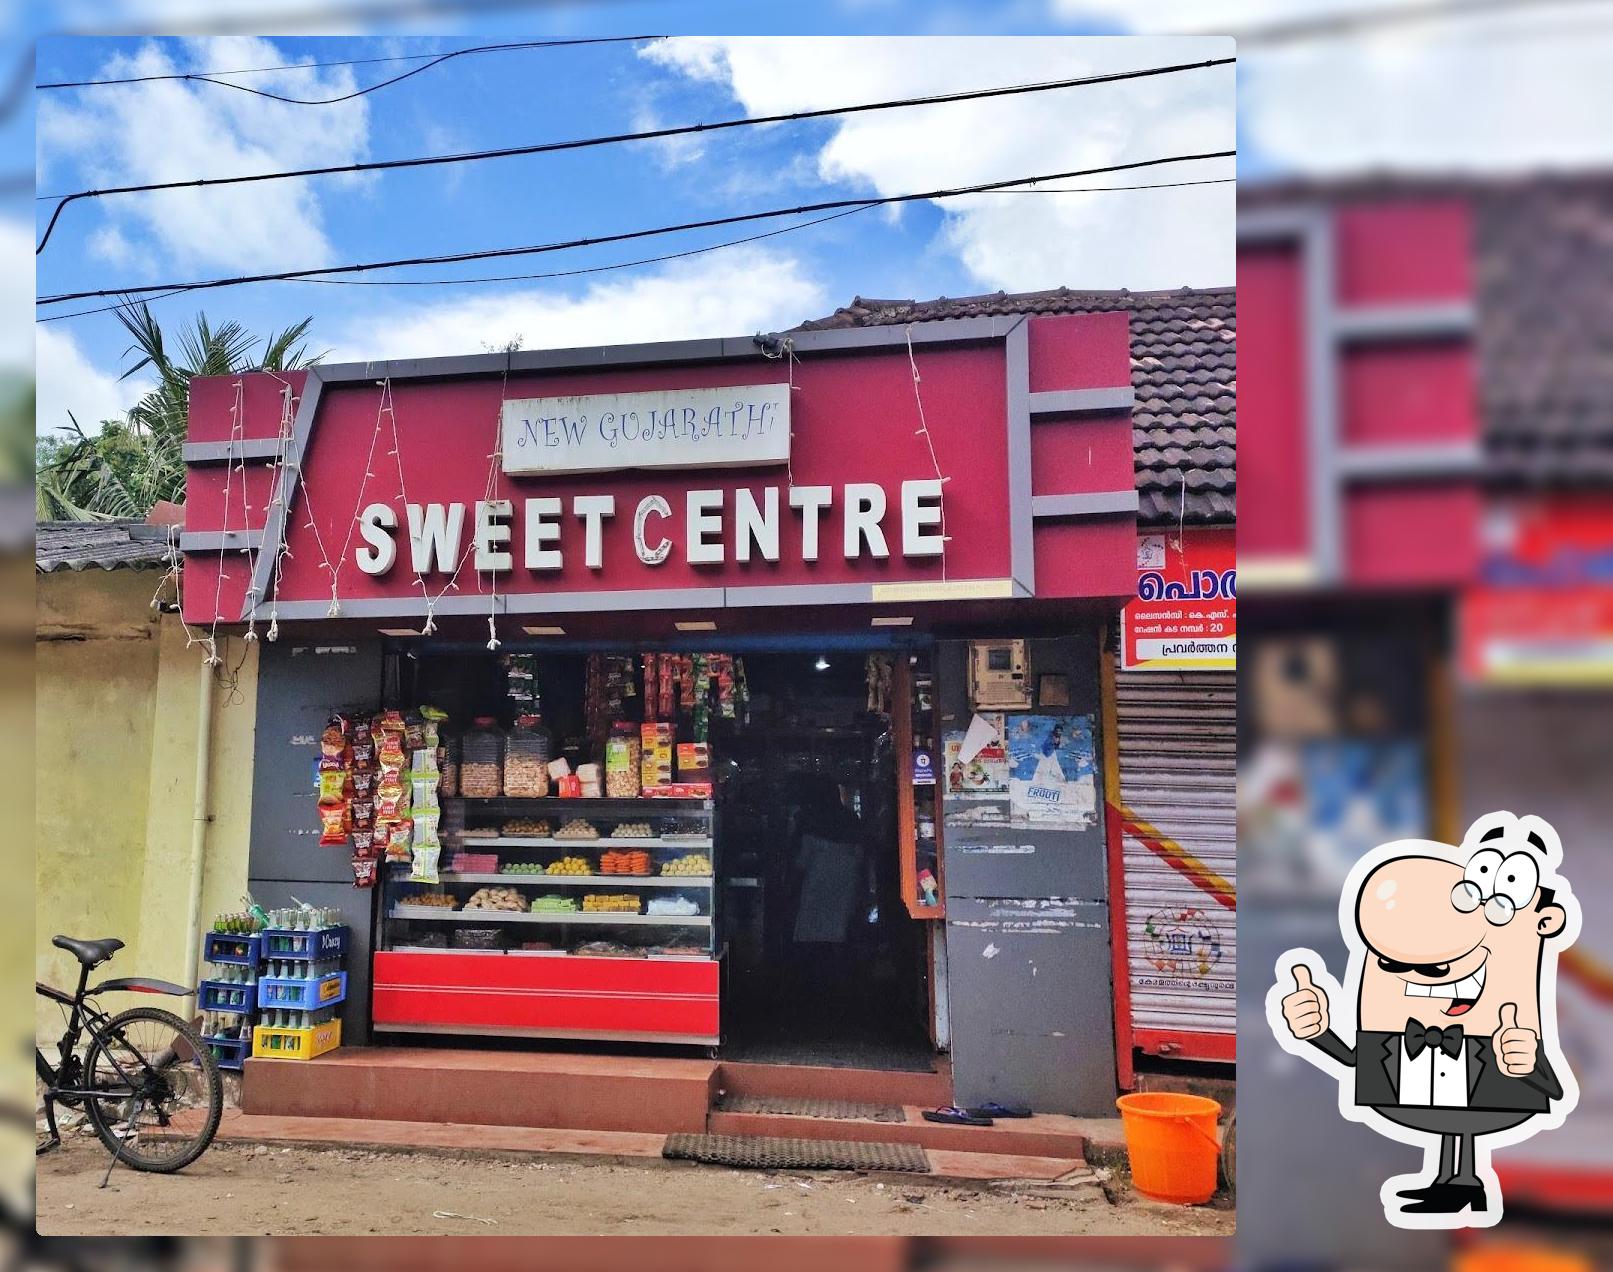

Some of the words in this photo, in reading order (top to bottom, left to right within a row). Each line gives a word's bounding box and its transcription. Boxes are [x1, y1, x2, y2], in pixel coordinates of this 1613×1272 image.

[517, 414, 588, 448] NEW
[355, 494, 616, 575] SWEET
[633, 479, 944, 565] CENTRE
[1210, 623, 1223, 633] 20
